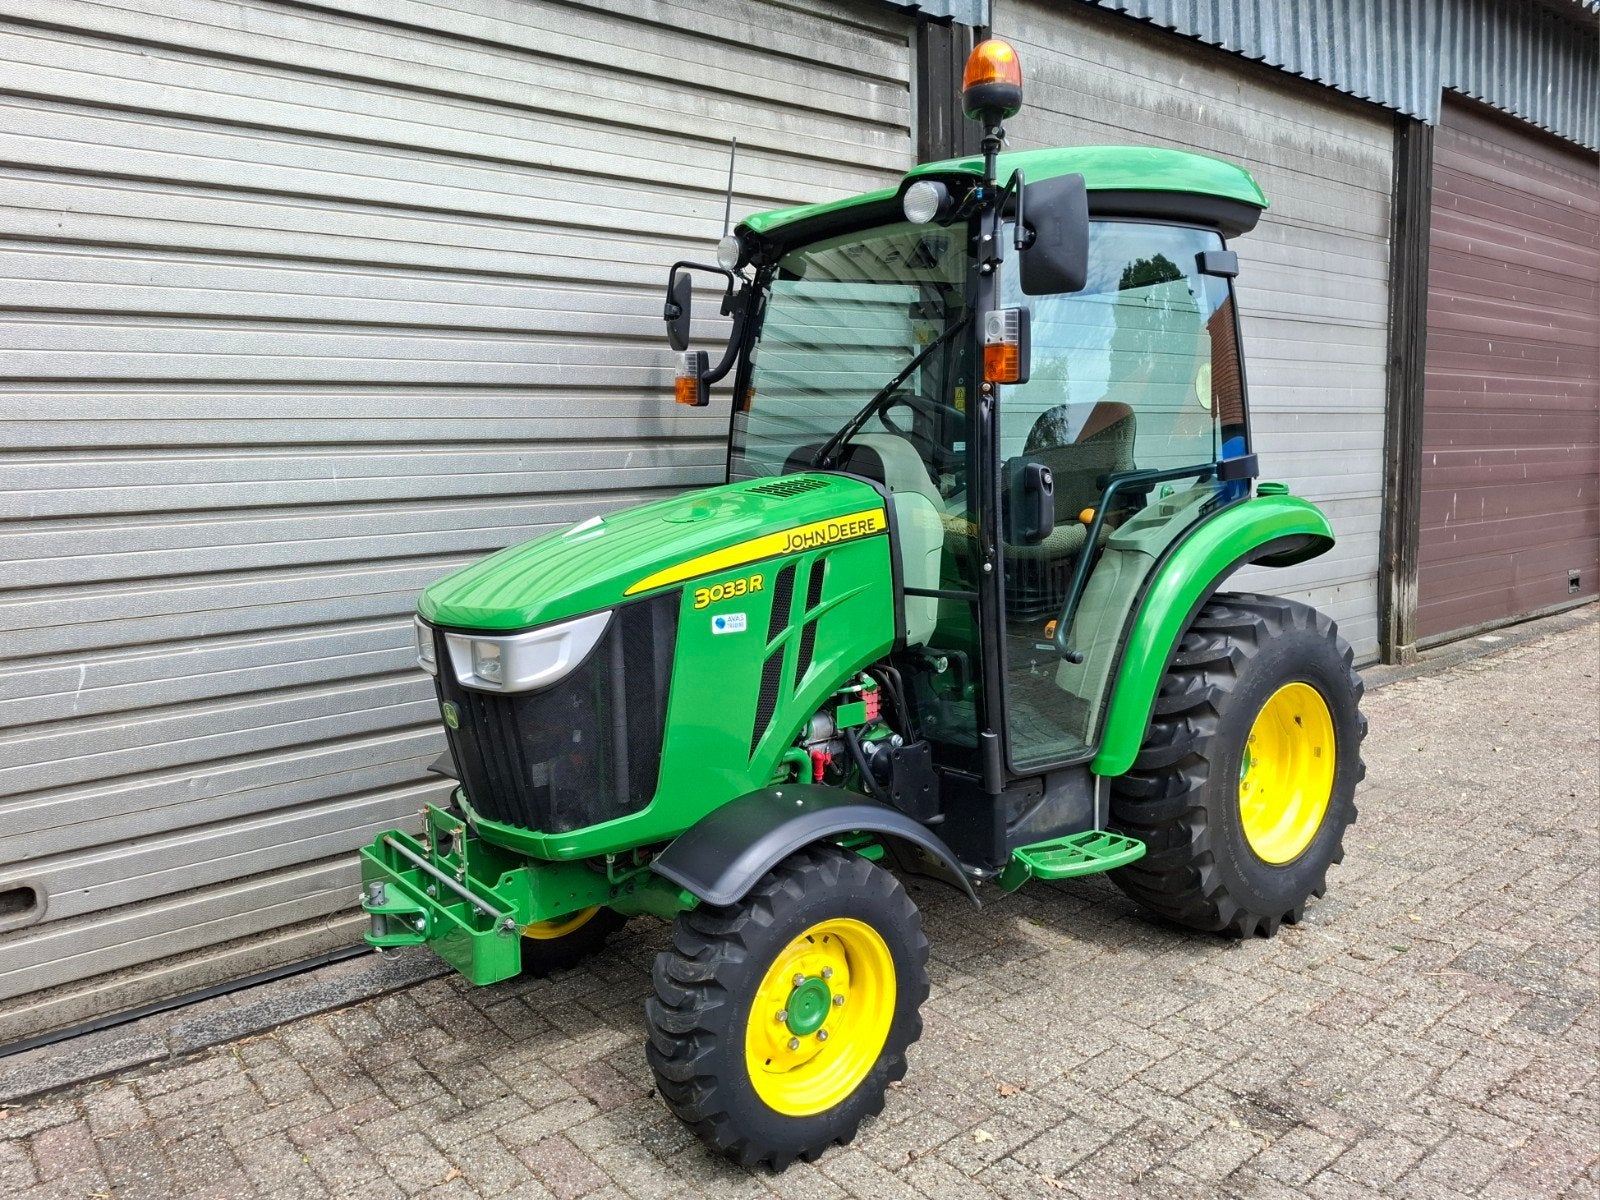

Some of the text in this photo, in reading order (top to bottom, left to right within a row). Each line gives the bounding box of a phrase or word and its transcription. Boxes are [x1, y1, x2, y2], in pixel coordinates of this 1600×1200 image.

[783, 518, 876, 551] JOHN DEERE
[726, 614, 745, 623] AVAS
